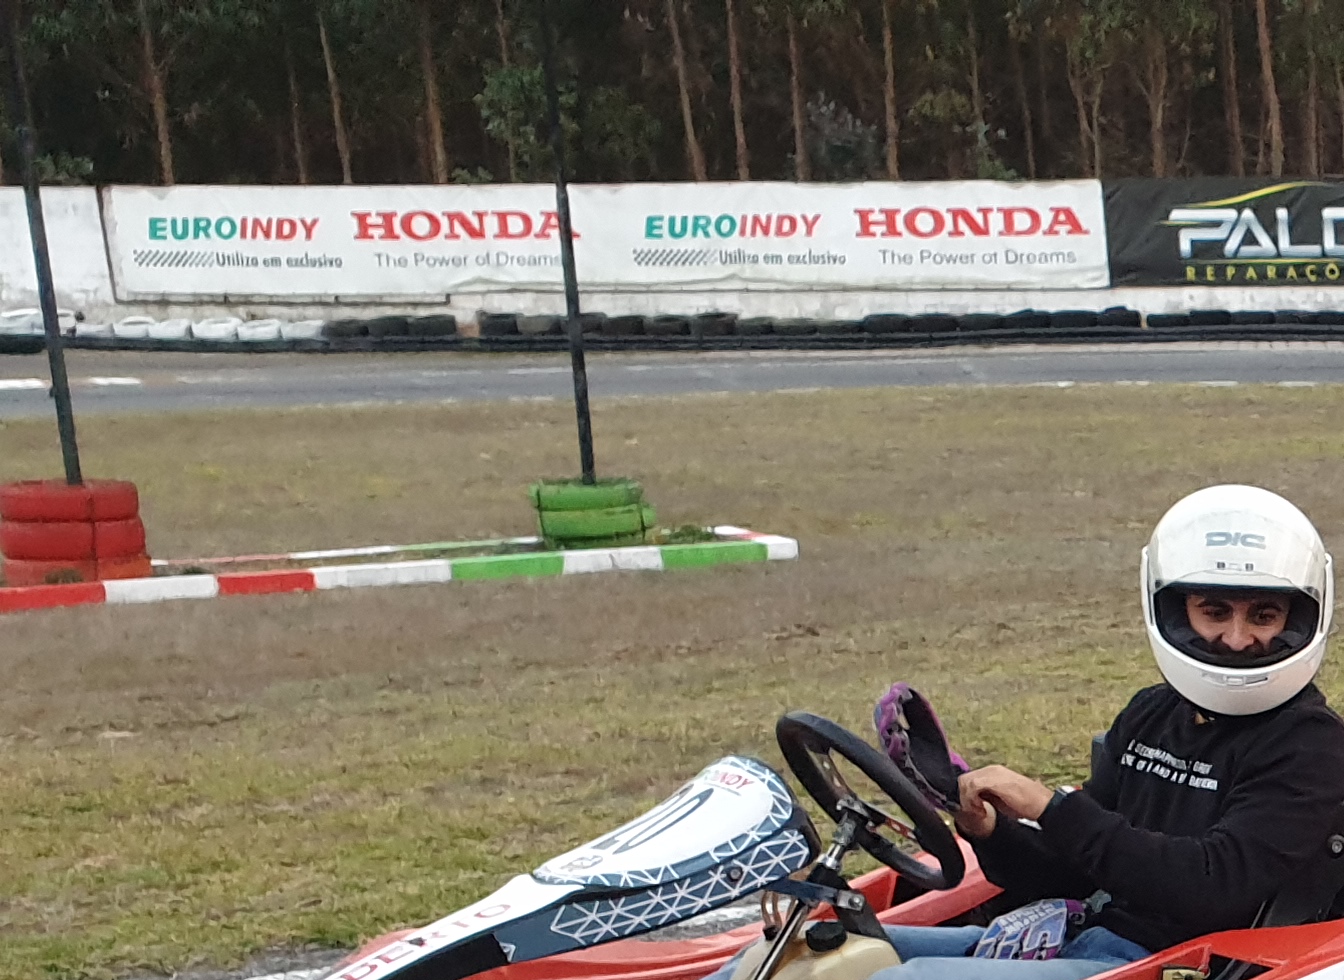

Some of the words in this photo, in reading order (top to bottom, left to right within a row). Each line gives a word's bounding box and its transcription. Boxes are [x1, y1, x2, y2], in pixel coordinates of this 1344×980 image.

[148, 216, 320, 241] EUROINDY
[350, 210, 581, 241] HONDA
[644, 213, 822, 239] EUROINDY
[853, 206, 1091, 239] HONDA
[263, 256, 282, 268] em
[286, 252, 343, 268] exclusivo
[374, 252, 408, 268] The
[413, 251, 468, 267] Power
[763, 254, 783, 265] em
[787, 249, 847, 266] exclusivo
[878, 249, 913, 265] The
[919, 249, 976, 265] Power
[1004, 249, 1078, 265] Dreams
[1205, 532, 1267, 550] DIC
